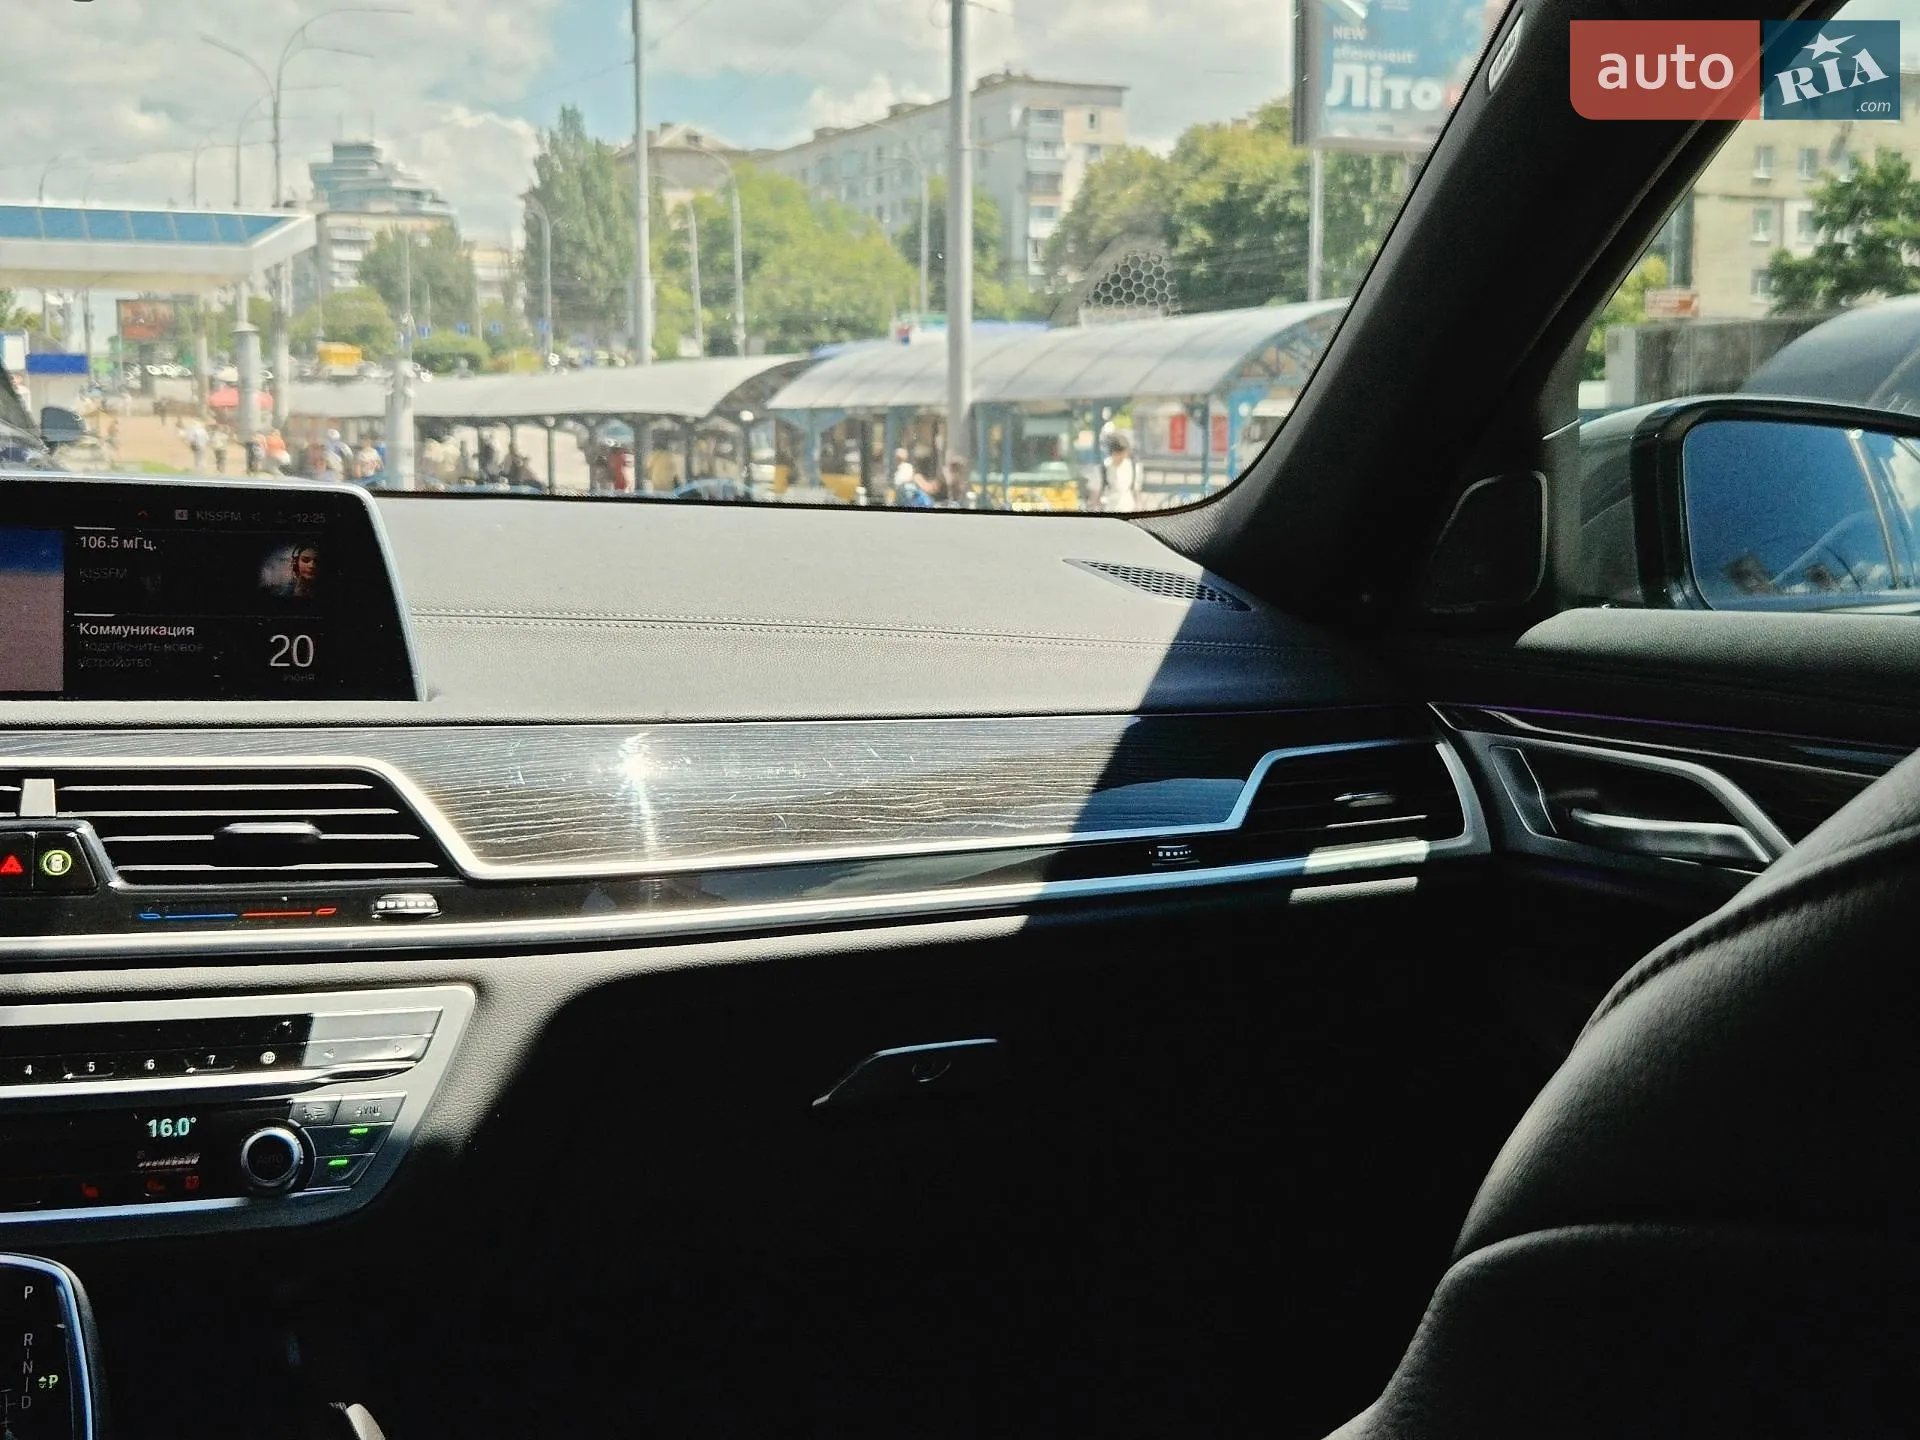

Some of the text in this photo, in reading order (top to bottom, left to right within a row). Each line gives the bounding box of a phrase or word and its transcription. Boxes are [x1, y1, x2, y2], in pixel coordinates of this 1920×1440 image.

[1332, 25, 1368, 41] NEW
[1325, 62, 1443, 112] Літо
[79, 536, 119, 549] 106.5
[79, 622, 195, 638] Коммуникация
[269, 634, 315, 667] 20
[24, 1054, 216, 1076] 4 5 6 7
[24, 1286, 34, 1300] P
[23, 1333, 33, 1346] R
[22, 1360, 33, 1374] N
[21, 1396, 32, 1409] D
